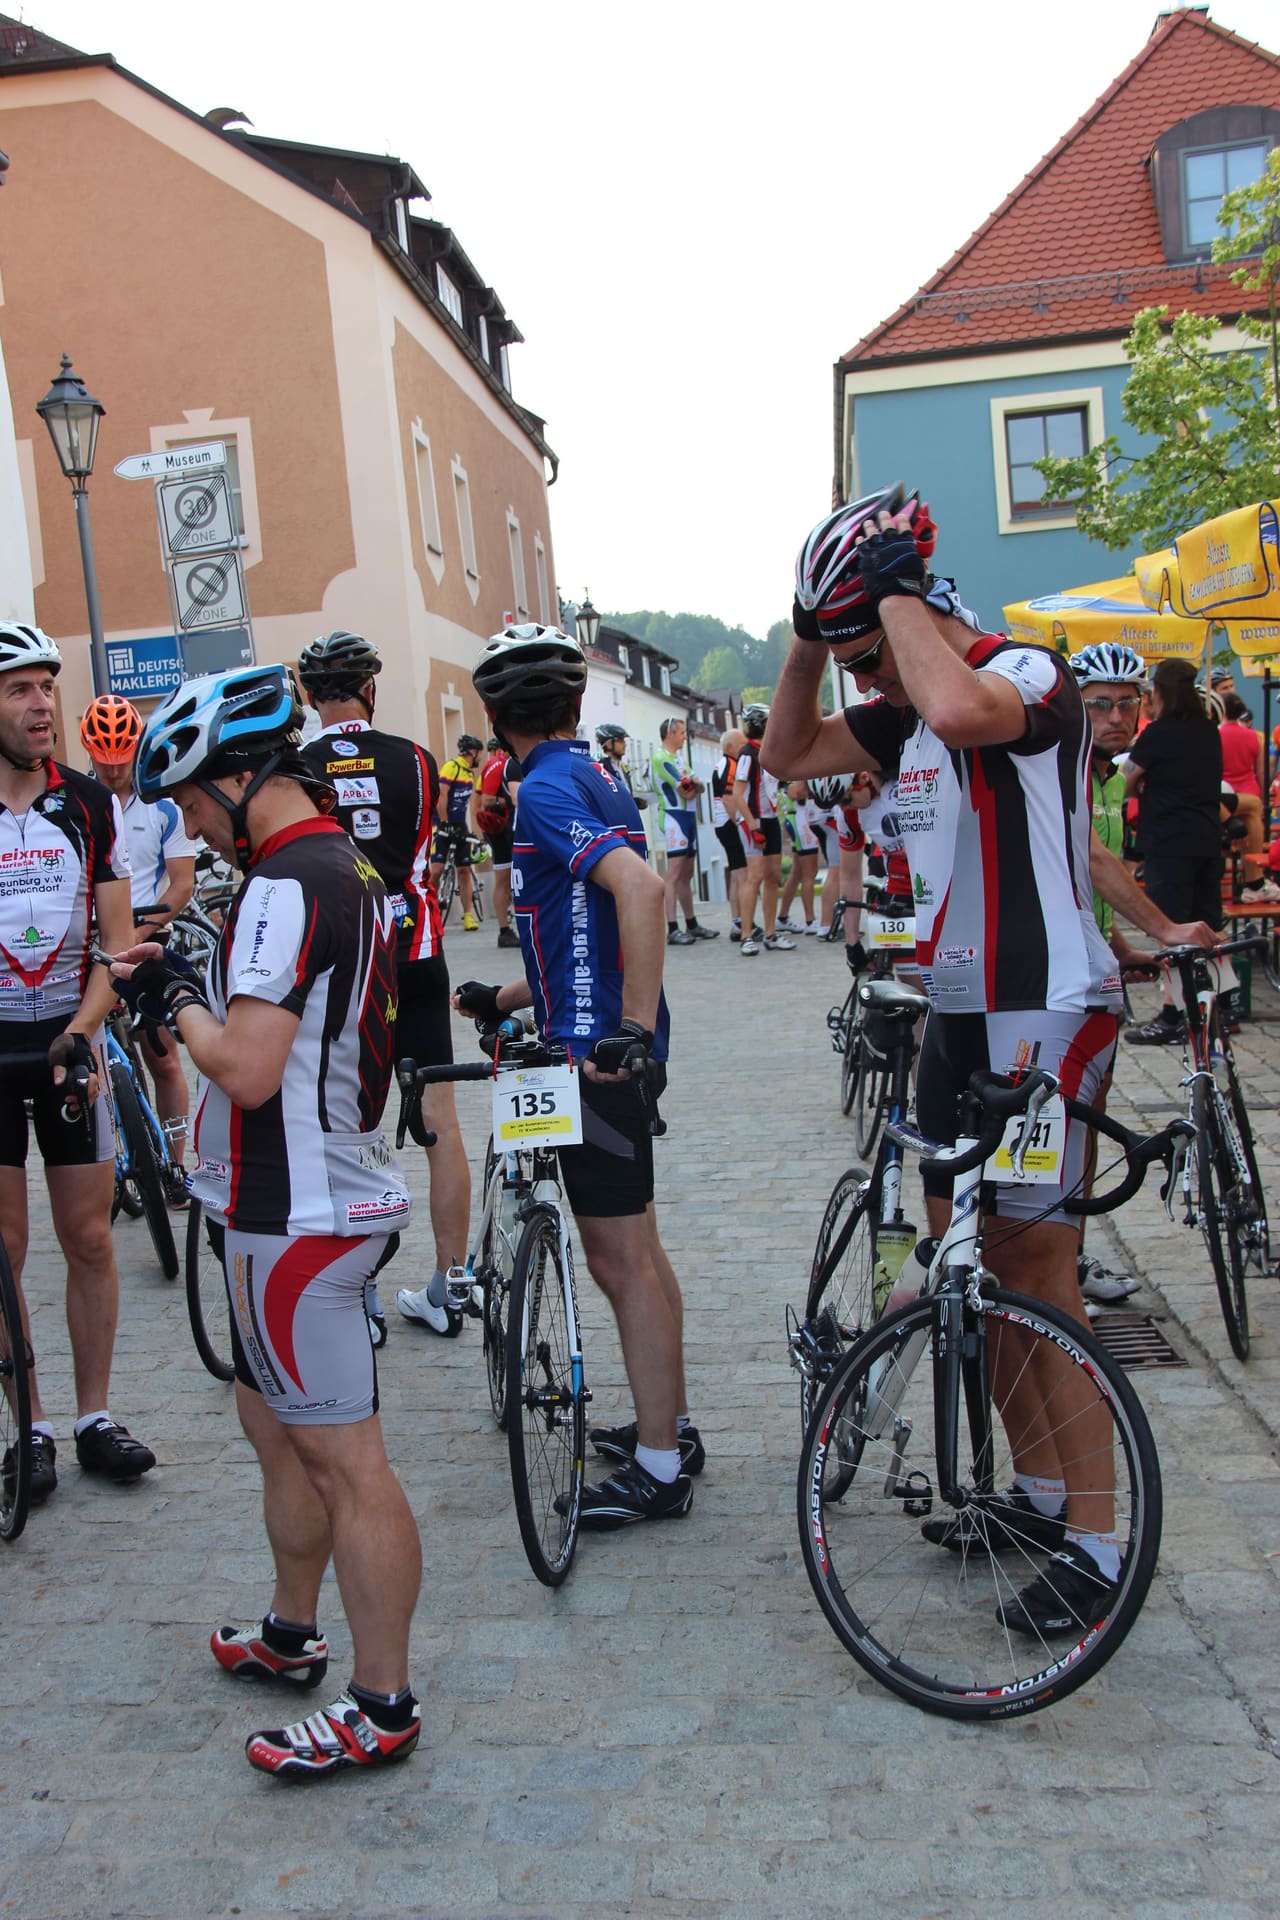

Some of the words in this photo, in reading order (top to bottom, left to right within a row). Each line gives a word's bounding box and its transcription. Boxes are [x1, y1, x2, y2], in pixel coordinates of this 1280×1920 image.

[165, 451, 212, 468] Museum
[184, 530, 217, 546] ZONE
[196, 608, 228, 622] ZONE
[329, 760, 371, 772] PowerBar
[342, 790, 373, 800] ARBER
[0, 848, 65, 862] eixner
[0, 884, 60, 896] Schwandorf
[880, 921, 906, 933] 130
[572, 880, 595, 1036] www.go-alps.de
[510, 1091, 557, 1118] 135
[1008, 1312, 1087, 1366] EASTON
[811, 1442, 826, 1538] EASTON
[1045, 1618, 1072, 1628] SIDI
[1001, 1645, 1082, 1695] EASTON
